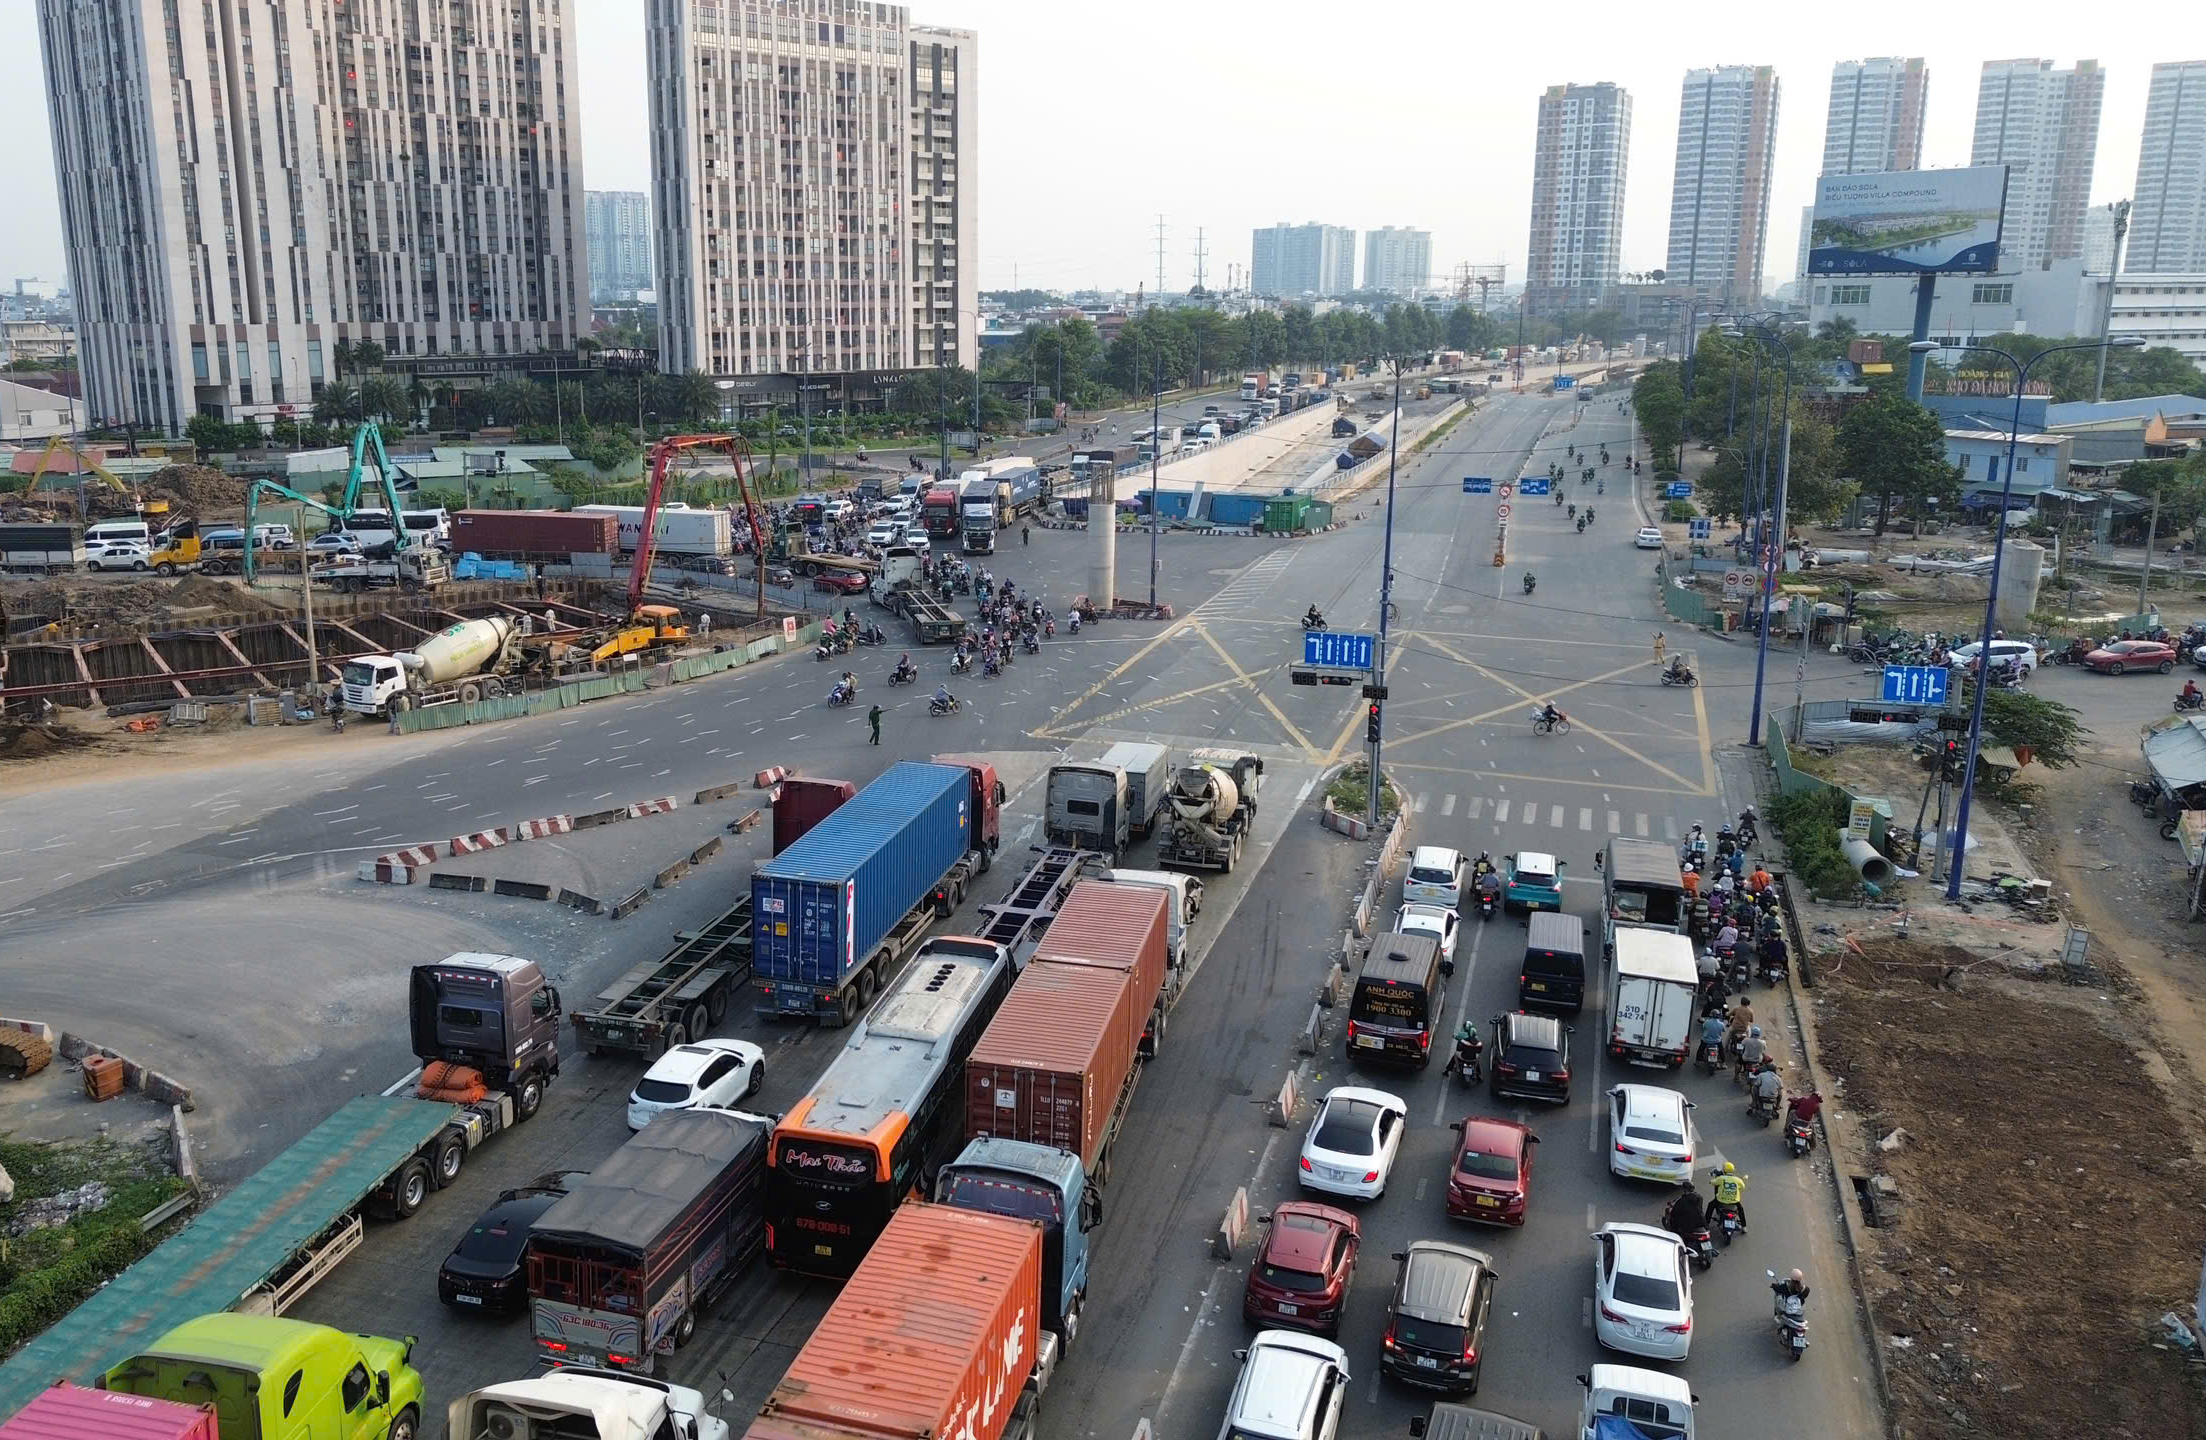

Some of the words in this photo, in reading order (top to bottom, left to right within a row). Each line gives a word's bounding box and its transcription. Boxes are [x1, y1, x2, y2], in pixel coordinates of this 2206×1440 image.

[1892, 189, 1937, 198] COMPOUND
[1366, 985, 1386, 994] ANH
[1366, 1003, 1387, 1013] 1900
[1388, 1007, 1412, 1016] 3300
[1625, 1004, 1640, 1013] 51D
[786, 1149, 822, 1168] Mai
[822, 1154, 867, 1173] Thảo
[1723, 1178, 1737, 1190] be
[562, 1314, 581, 1325] 63C
